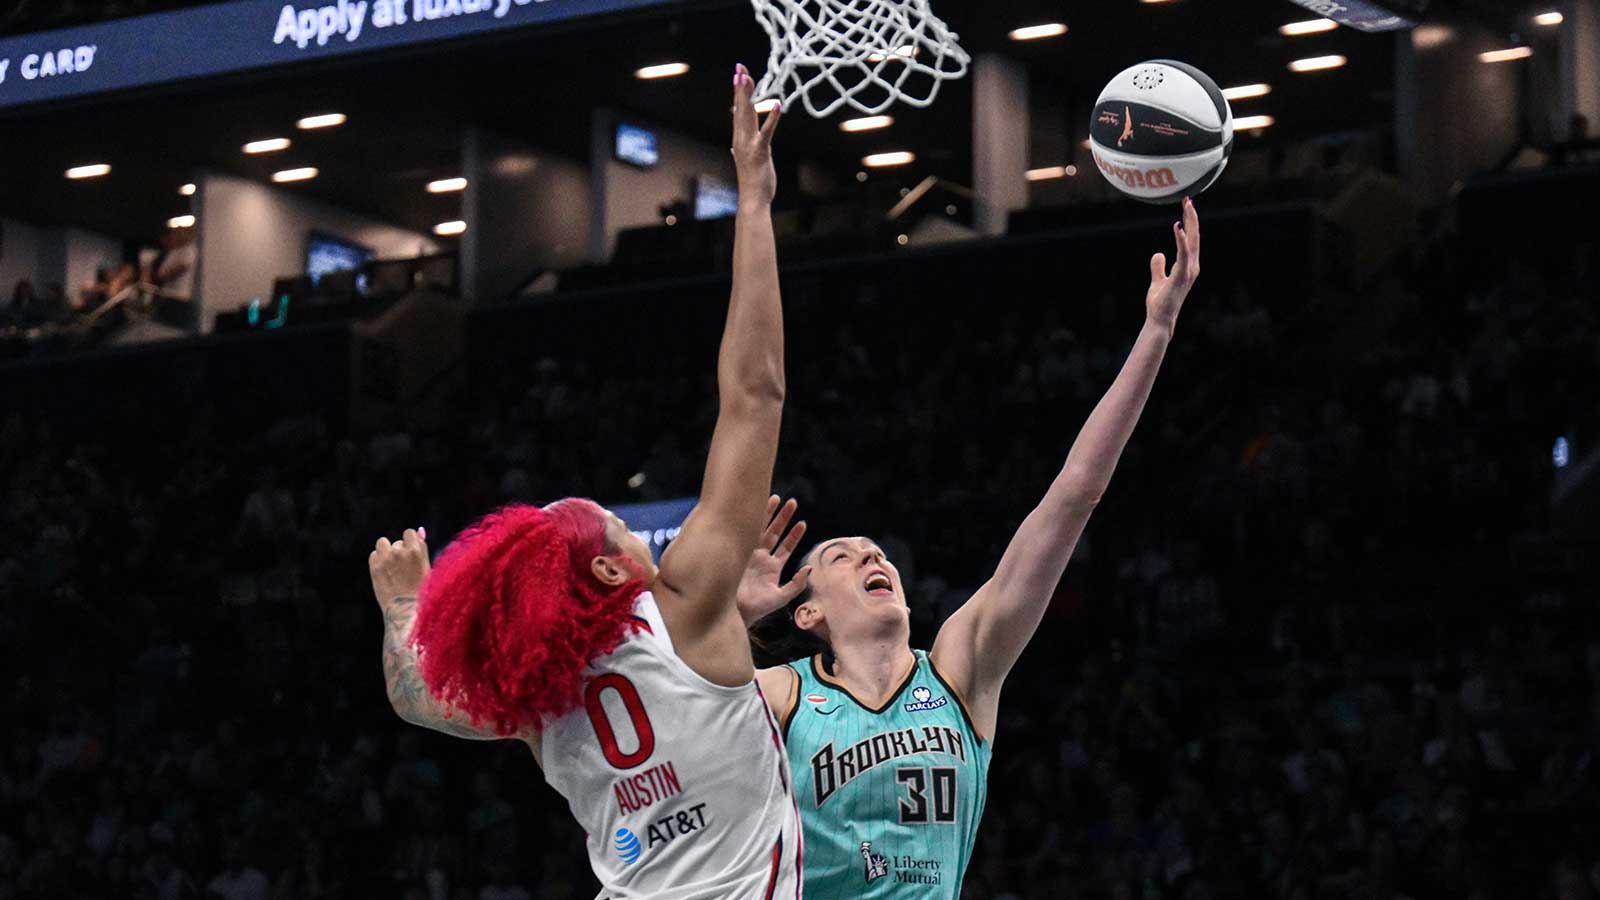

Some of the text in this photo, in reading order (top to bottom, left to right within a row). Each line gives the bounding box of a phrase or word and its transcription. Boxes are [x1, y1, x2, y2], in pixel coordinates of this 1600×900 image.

[273, 0, 368, 48] Apply
[21, 46, 97, 80] CARD
[585, 672, 655, 770] 0
[906, 698, 947, 712] BARCLAYS
[613, 761, 682, 816] AUSTIN
[896, 767, 957, 824] 30
[647, 803, 706, 848] AT&T
[893, 856, 941, 871] Liberty
[893, 871, 941, 885] Mutual
